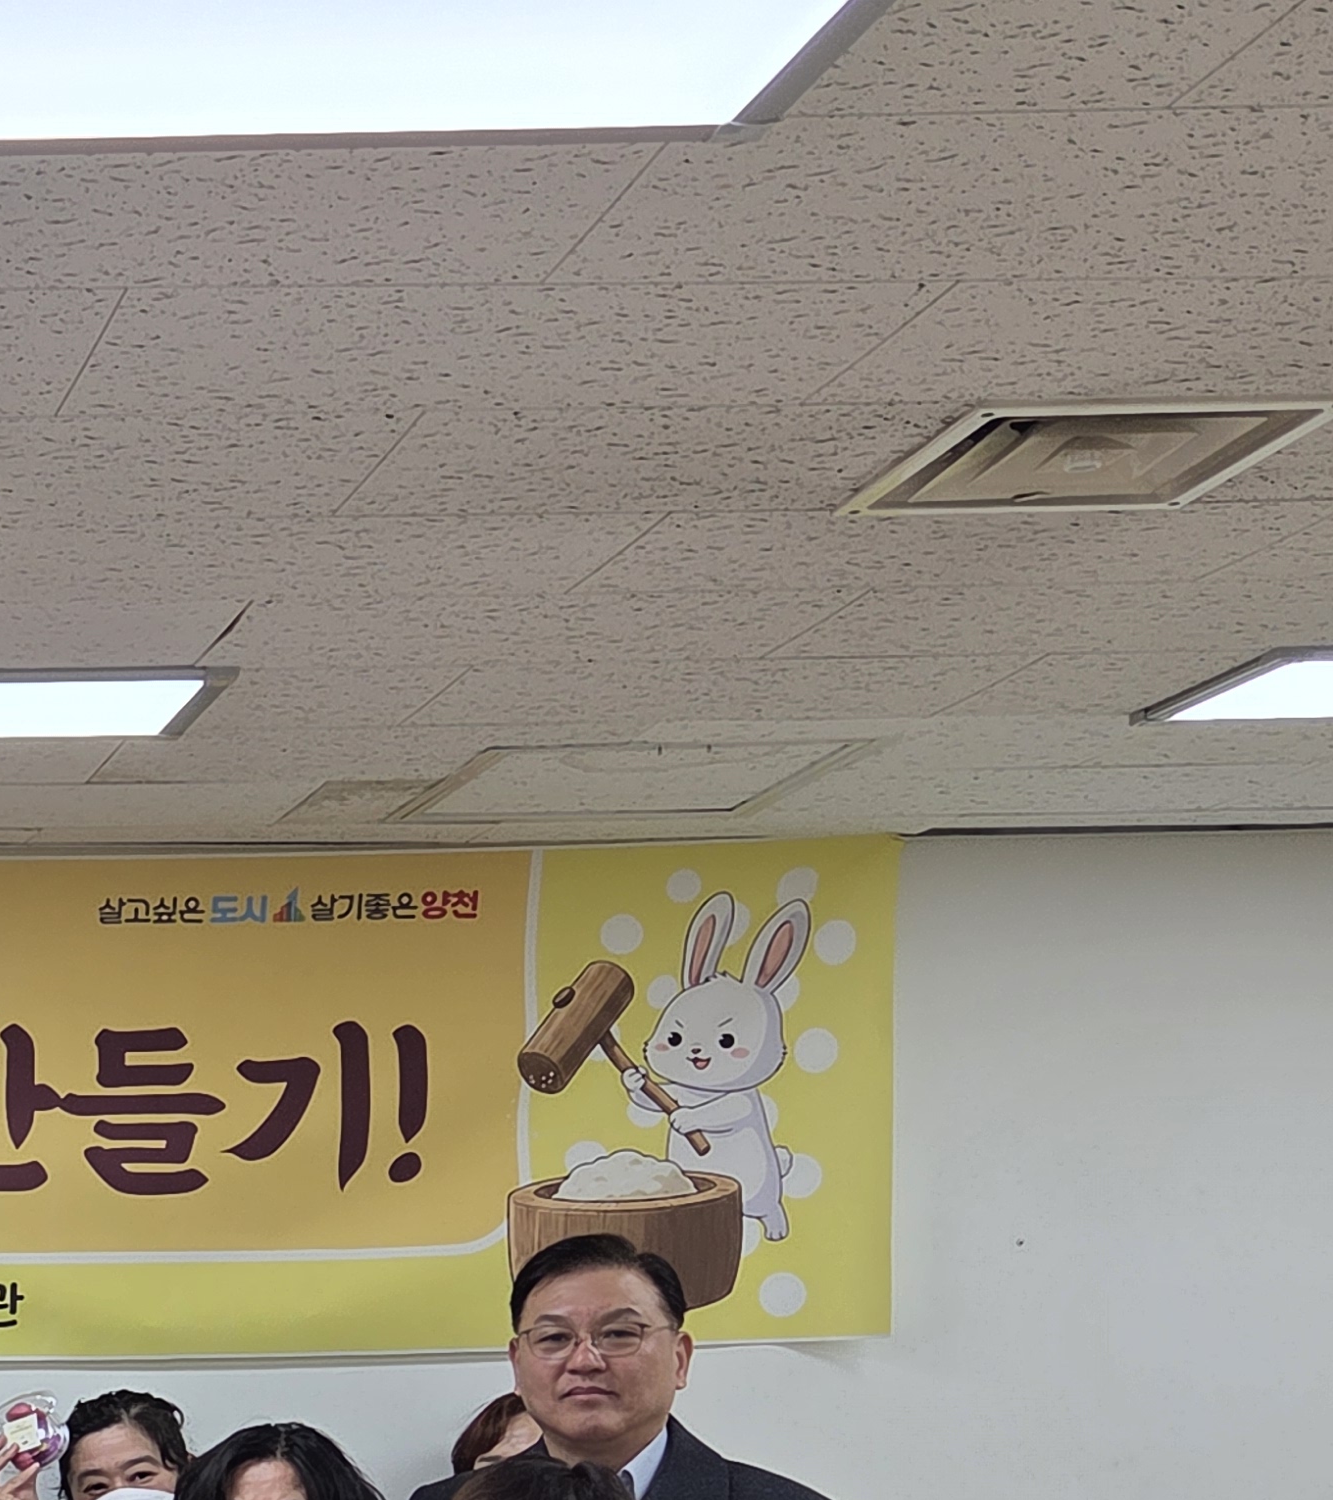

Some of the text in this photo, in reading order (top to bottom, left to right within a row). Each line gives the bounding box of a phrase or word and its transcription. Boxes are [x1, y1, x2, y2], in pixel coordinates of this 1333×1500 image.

[98, 890, 479, 924] 살고싶은 도시 살기좋은 양천
